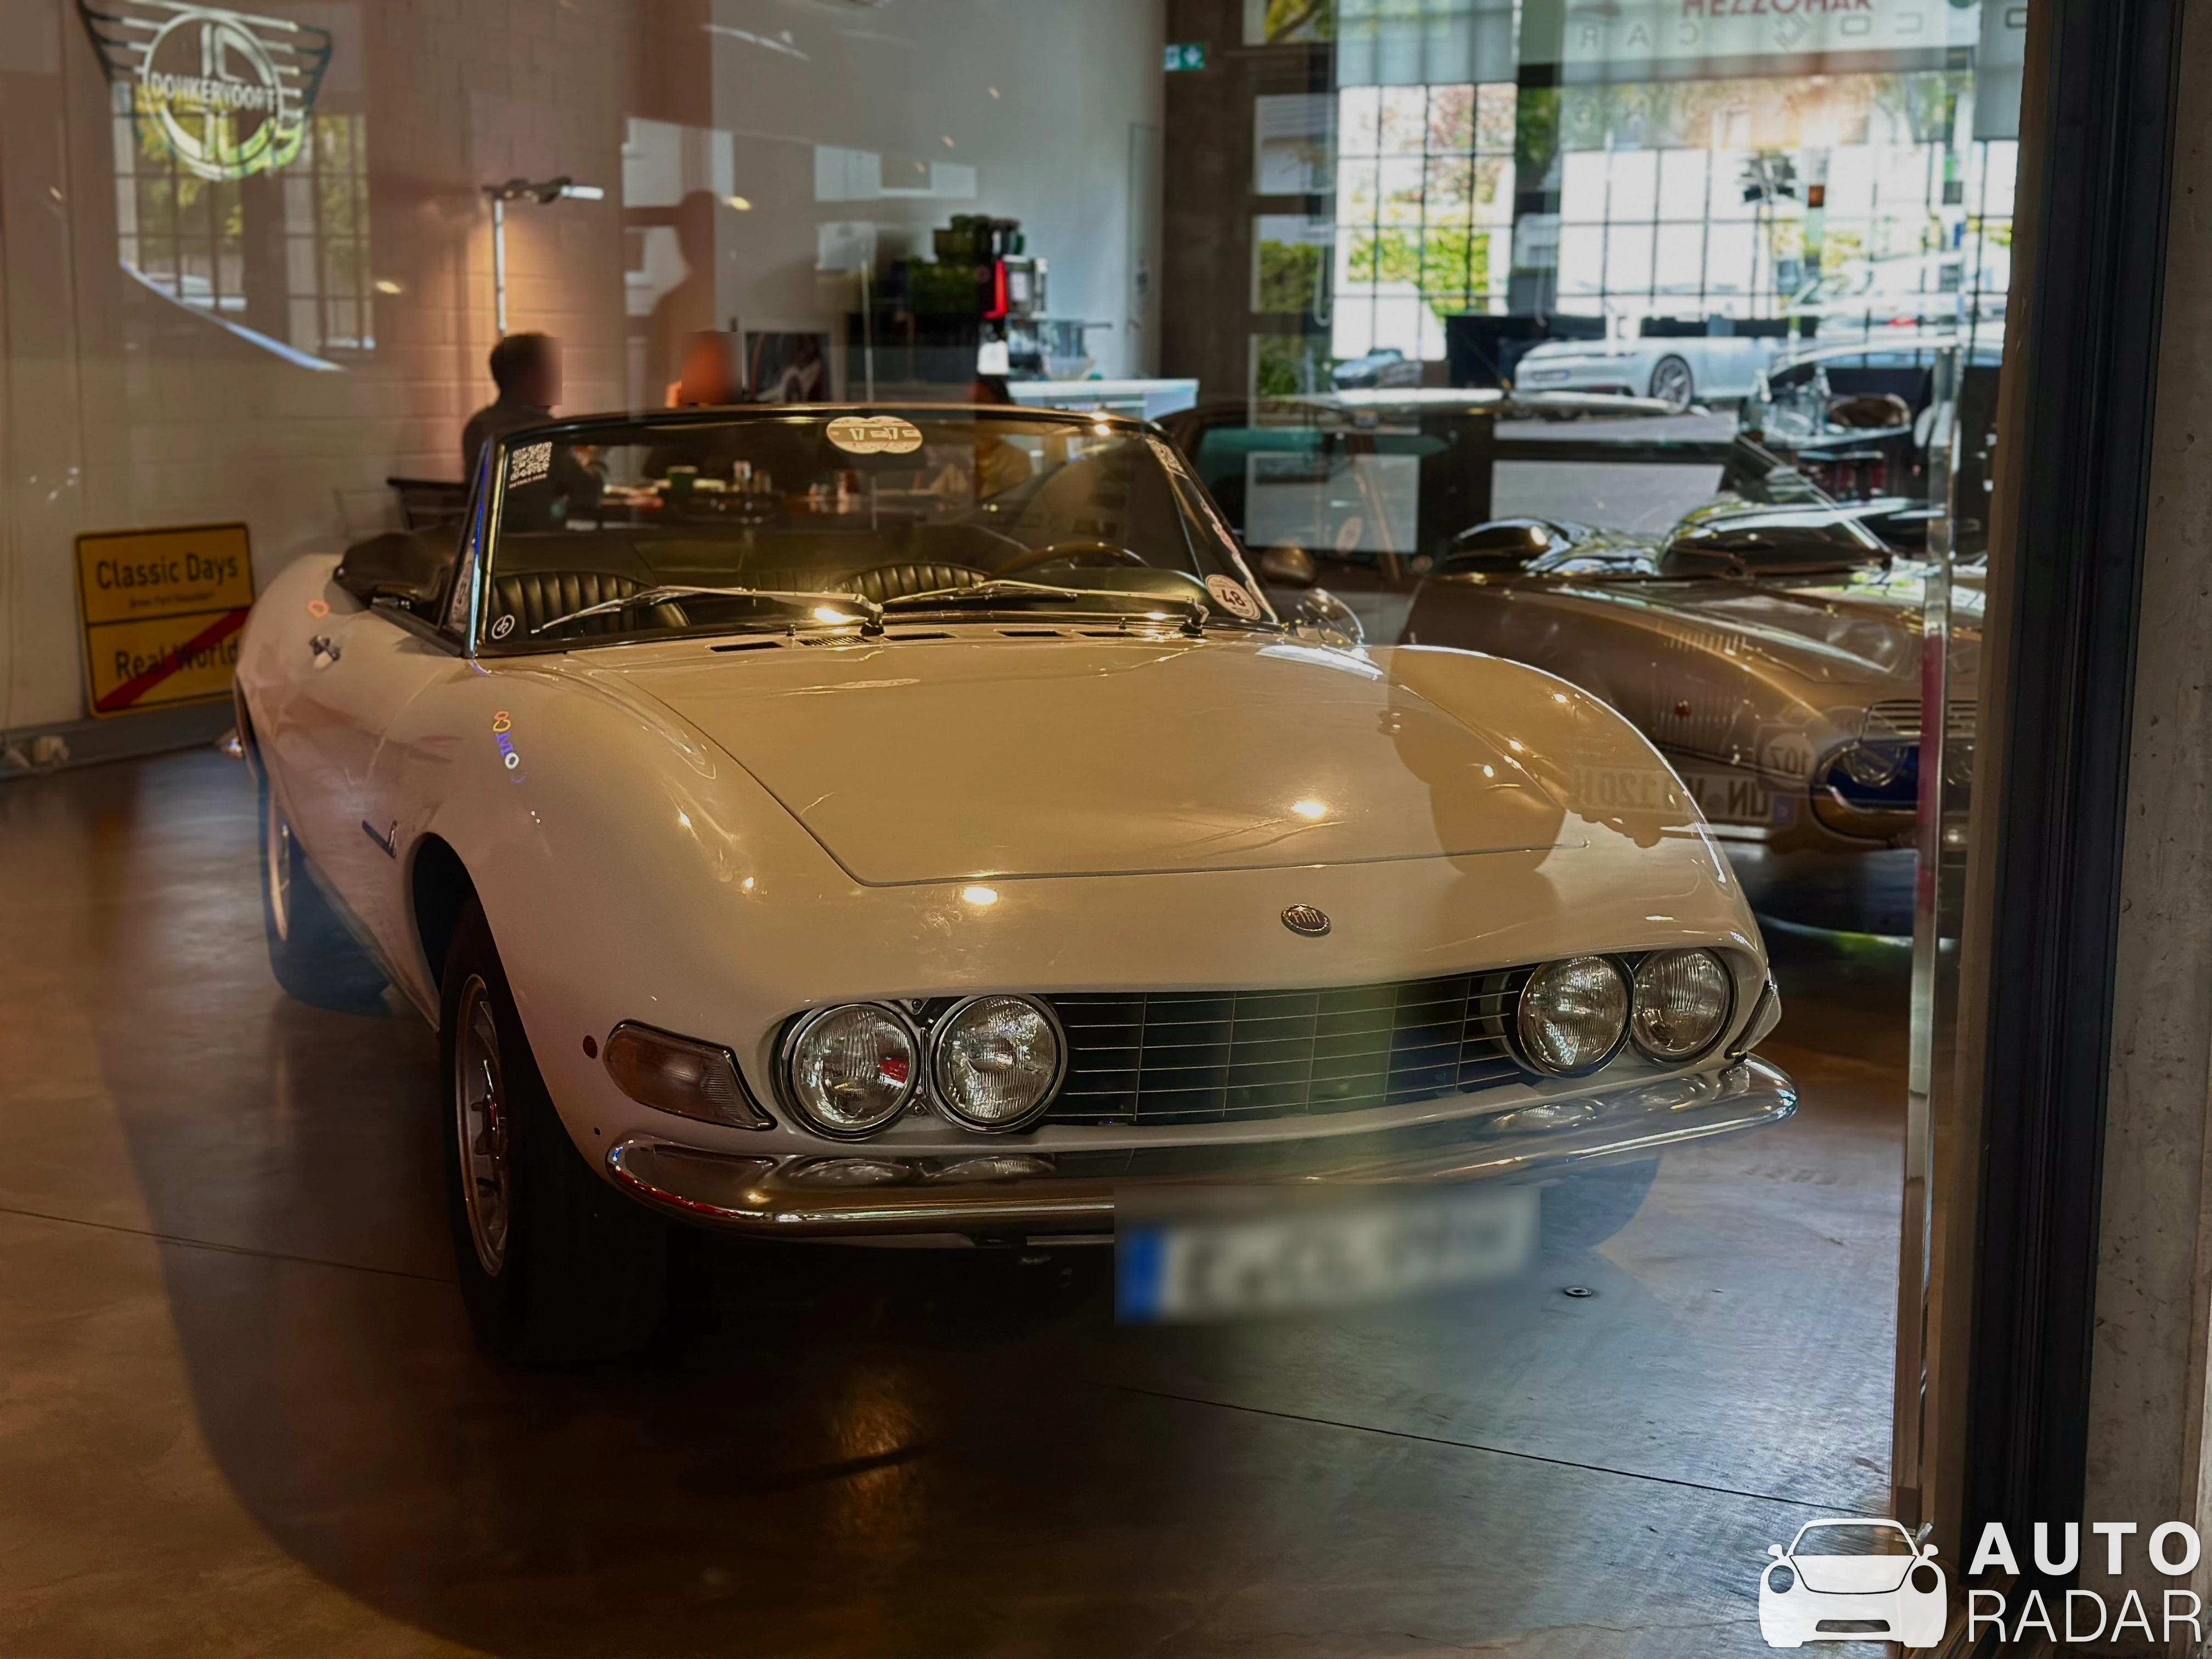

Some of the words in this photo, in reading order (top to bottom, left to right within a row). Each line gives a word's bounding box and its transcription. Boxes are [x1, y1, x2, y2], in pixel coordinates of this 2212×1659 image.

[95, 555, 179, 590] Classic
[185, 551, 238, 587] Days
[1221, 589, 1246, 607] 48
[114, 645, 165, 681] Real
[173, 636, 239, 672] World
[1290, 910, 1321, 923] FIAT
